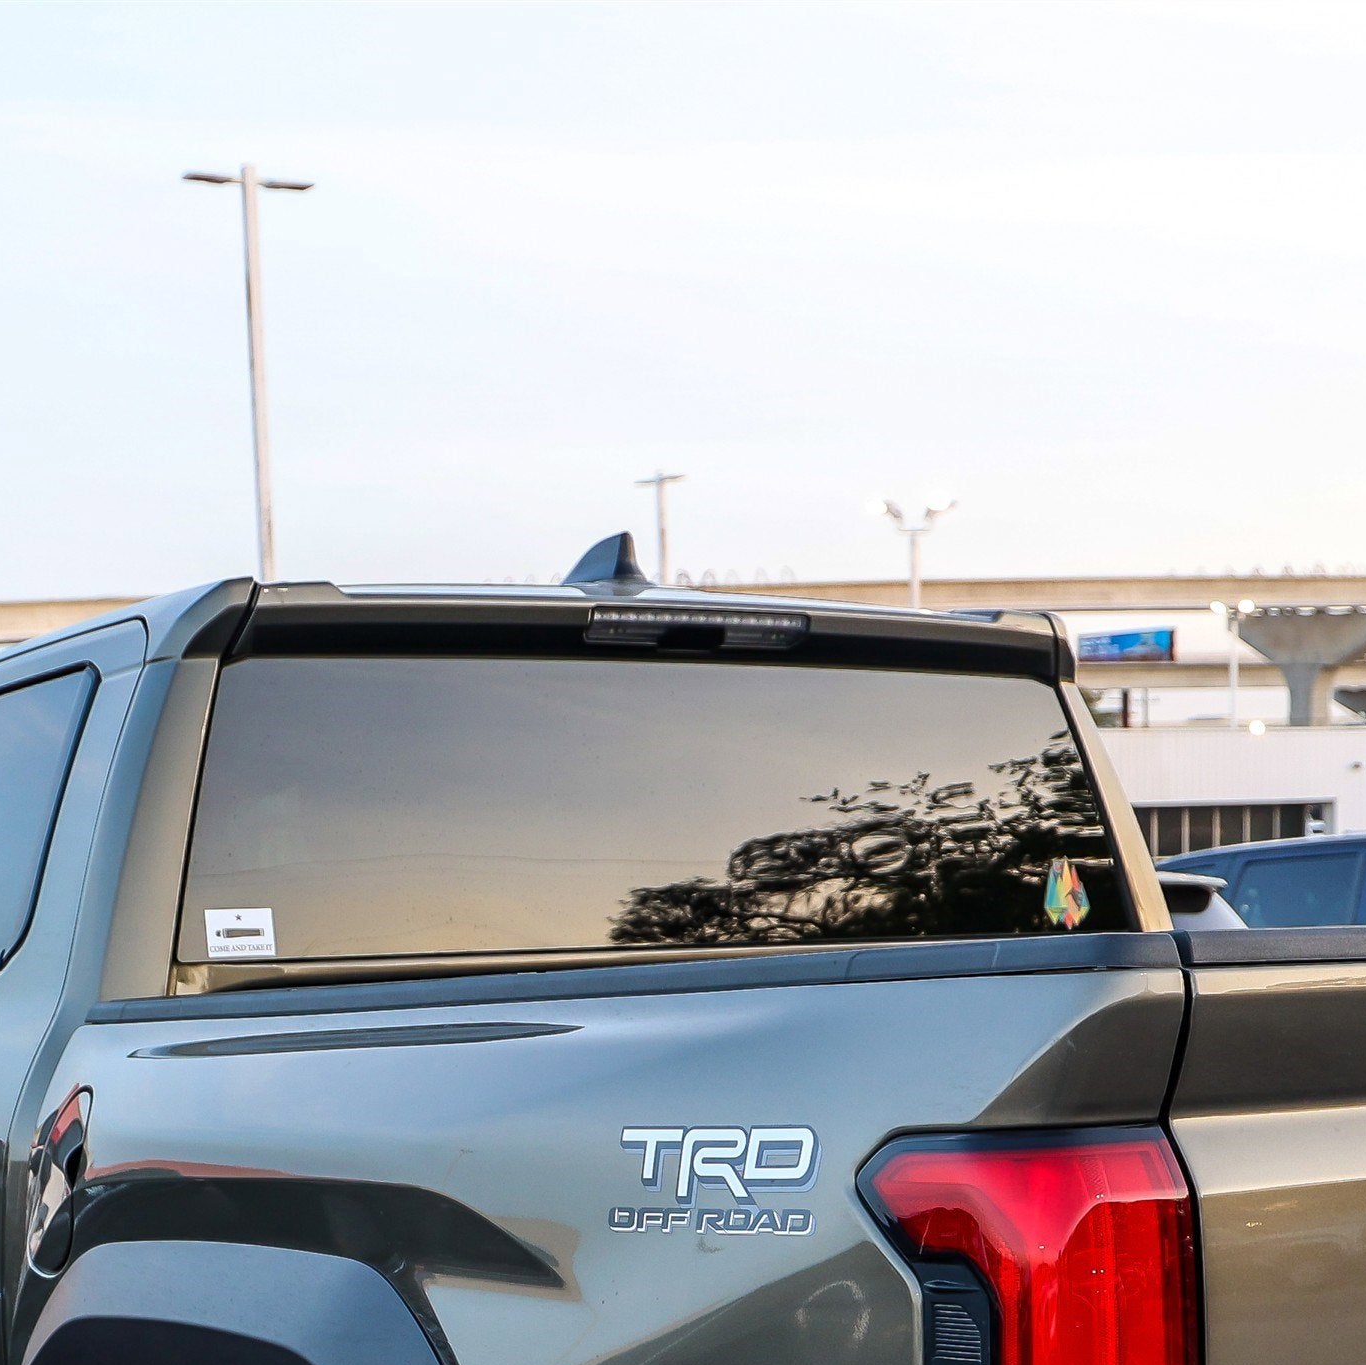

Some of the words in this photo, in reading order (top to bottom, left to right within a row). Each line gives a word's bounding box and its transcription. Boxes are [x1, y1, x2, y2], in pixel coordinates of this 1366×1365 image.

[209, 944, 230, 953] COME
[231, 943, 246, 952] AND
[248, 943, 265, 951] TAKE
[265, 942, 273, 951] IT
[620, 1125, 821, 1206] TRD
[608, 1207, 691, 1234] OFF
[696, 1207, 817, 1236] ROAD
